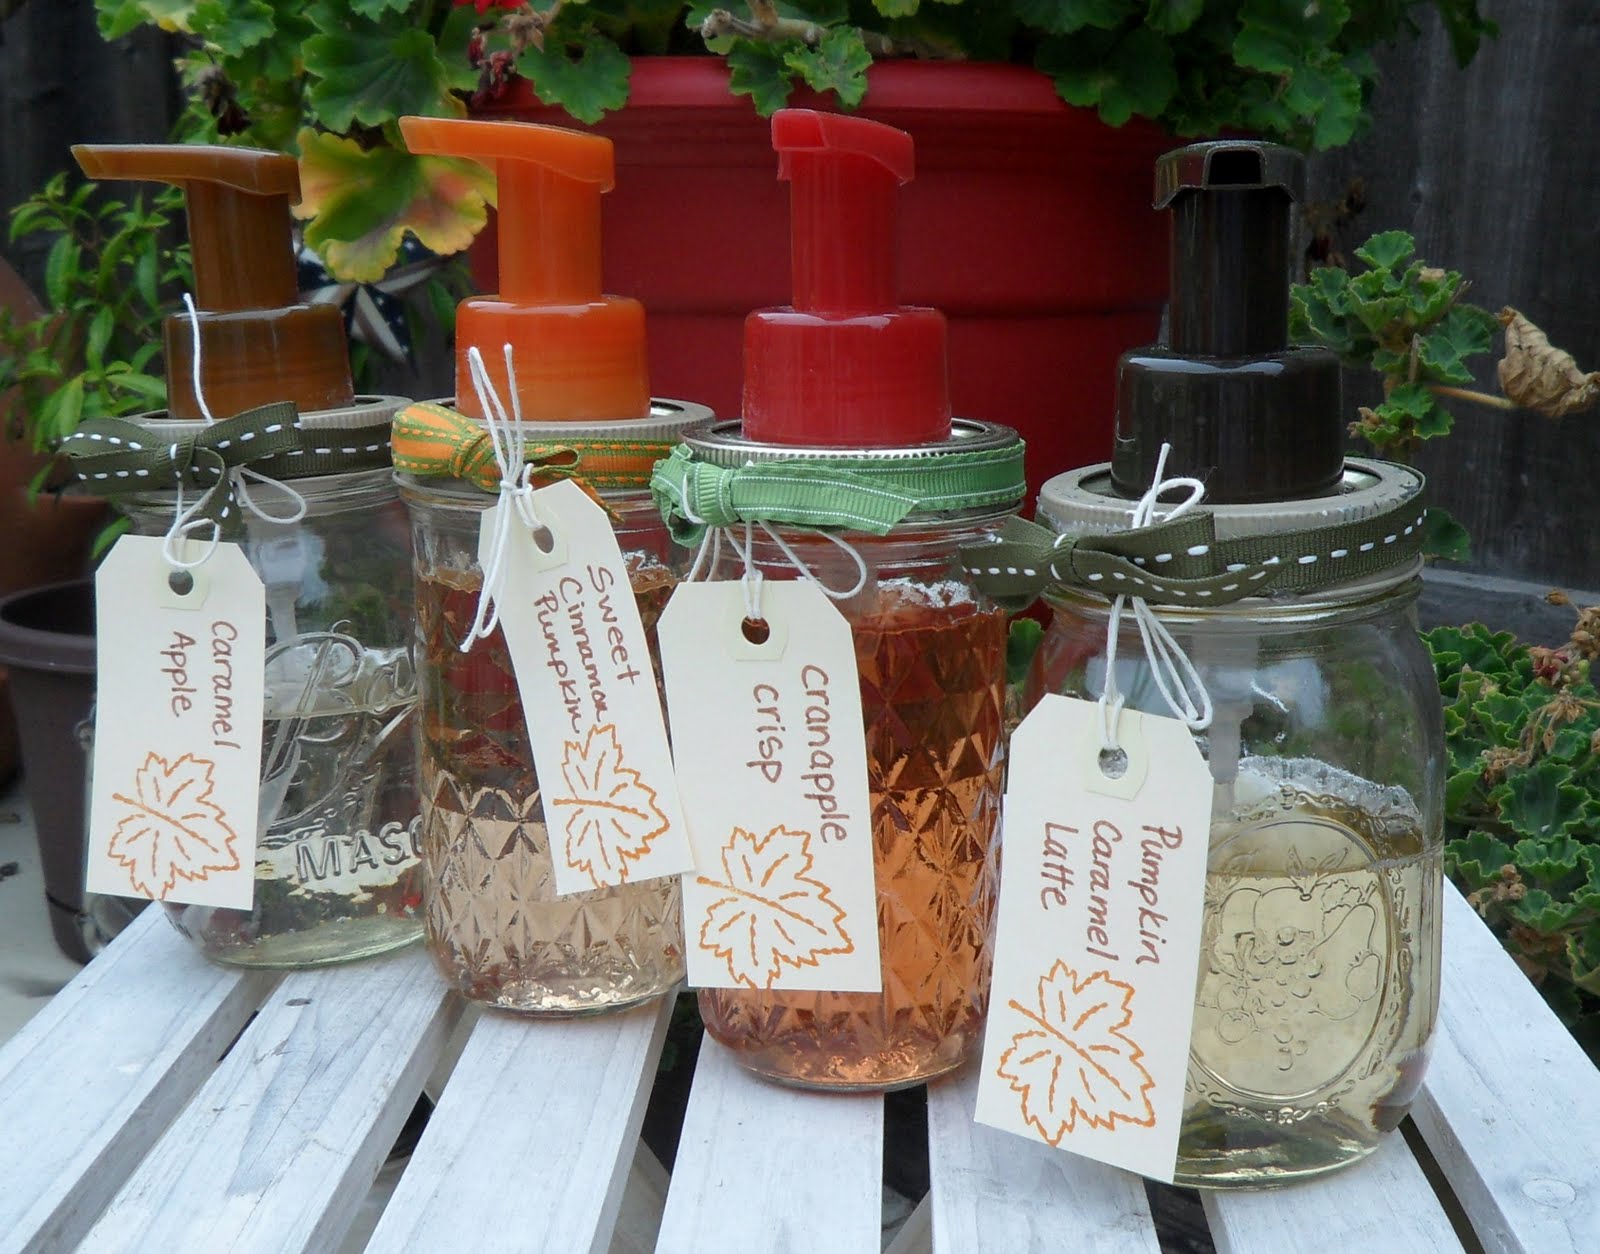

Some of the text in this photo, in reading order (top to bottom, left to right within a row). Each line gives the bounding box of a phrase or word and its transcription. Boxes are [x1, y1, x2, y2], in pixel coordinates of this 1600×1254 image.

[160, 631, 197, 718] Apple
[211, 620, 241, 750] Caramel
[533, 589, 582, 734] Pumpkin
[587, 565, 641, 686] Sweet
[1040, 822, 1079, 910] Latte
[1086, 820, 1123, 961] Caramel
[1127, 825, 1183, 965] Pumpkin
